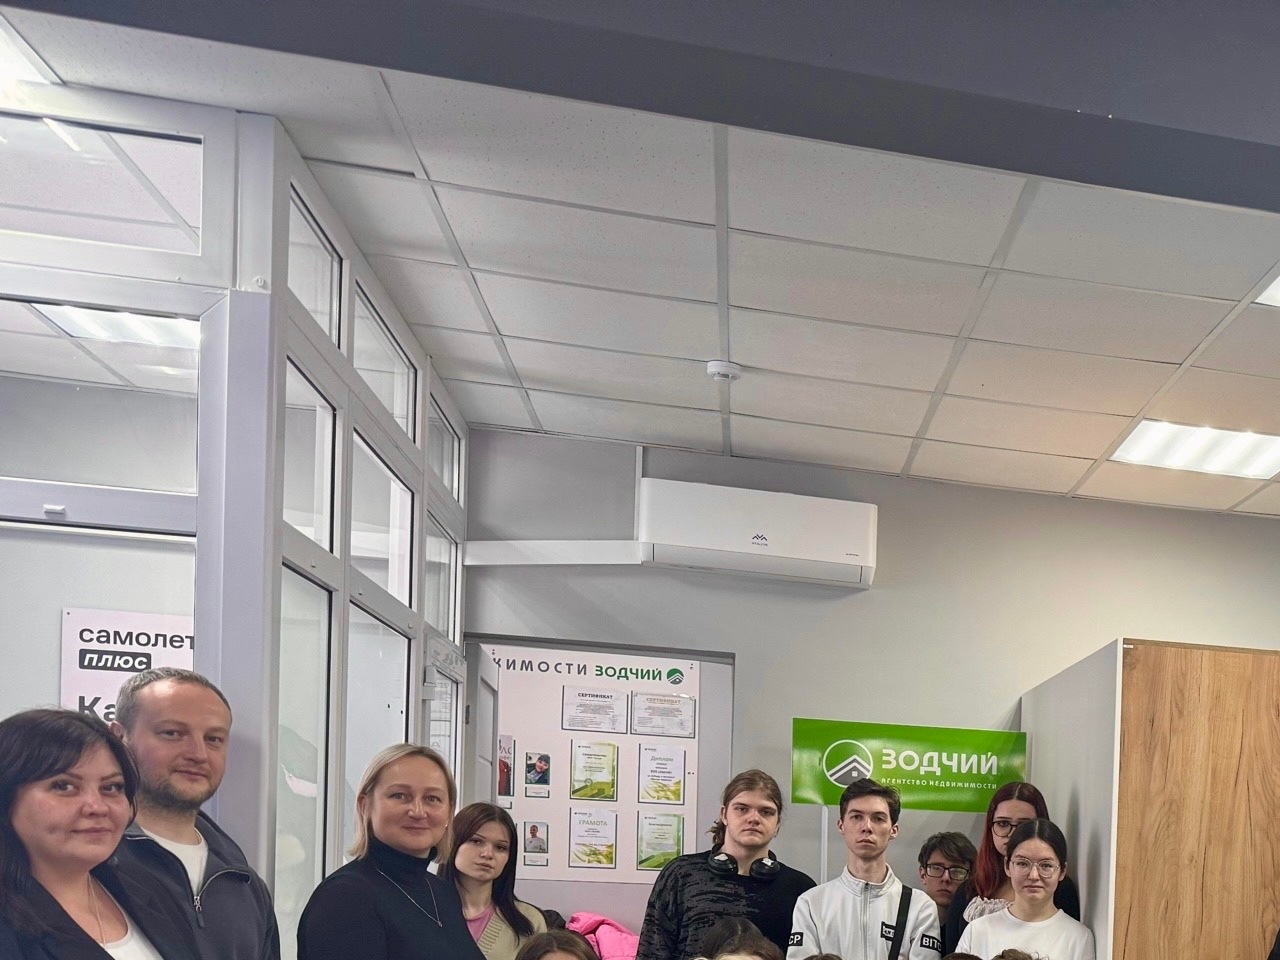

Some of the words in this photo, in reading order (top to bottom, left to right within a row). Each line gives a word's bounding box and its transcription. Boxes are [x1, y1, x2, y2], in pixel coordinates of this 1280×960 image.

[79, 628, 194, 650] самолет
[84, 654, 148, 670] плюс
[595, 665, 662, 681] ЗОДЧИЙ
[78, 695, 116, 722] Ка
[882, 748, 998, 776] ЗОДЧИЙ
[881, 777, 927, 786] АГЕНТСТВО
[929, 780, 997, 790] НЕДВИЖИМОСТИ
